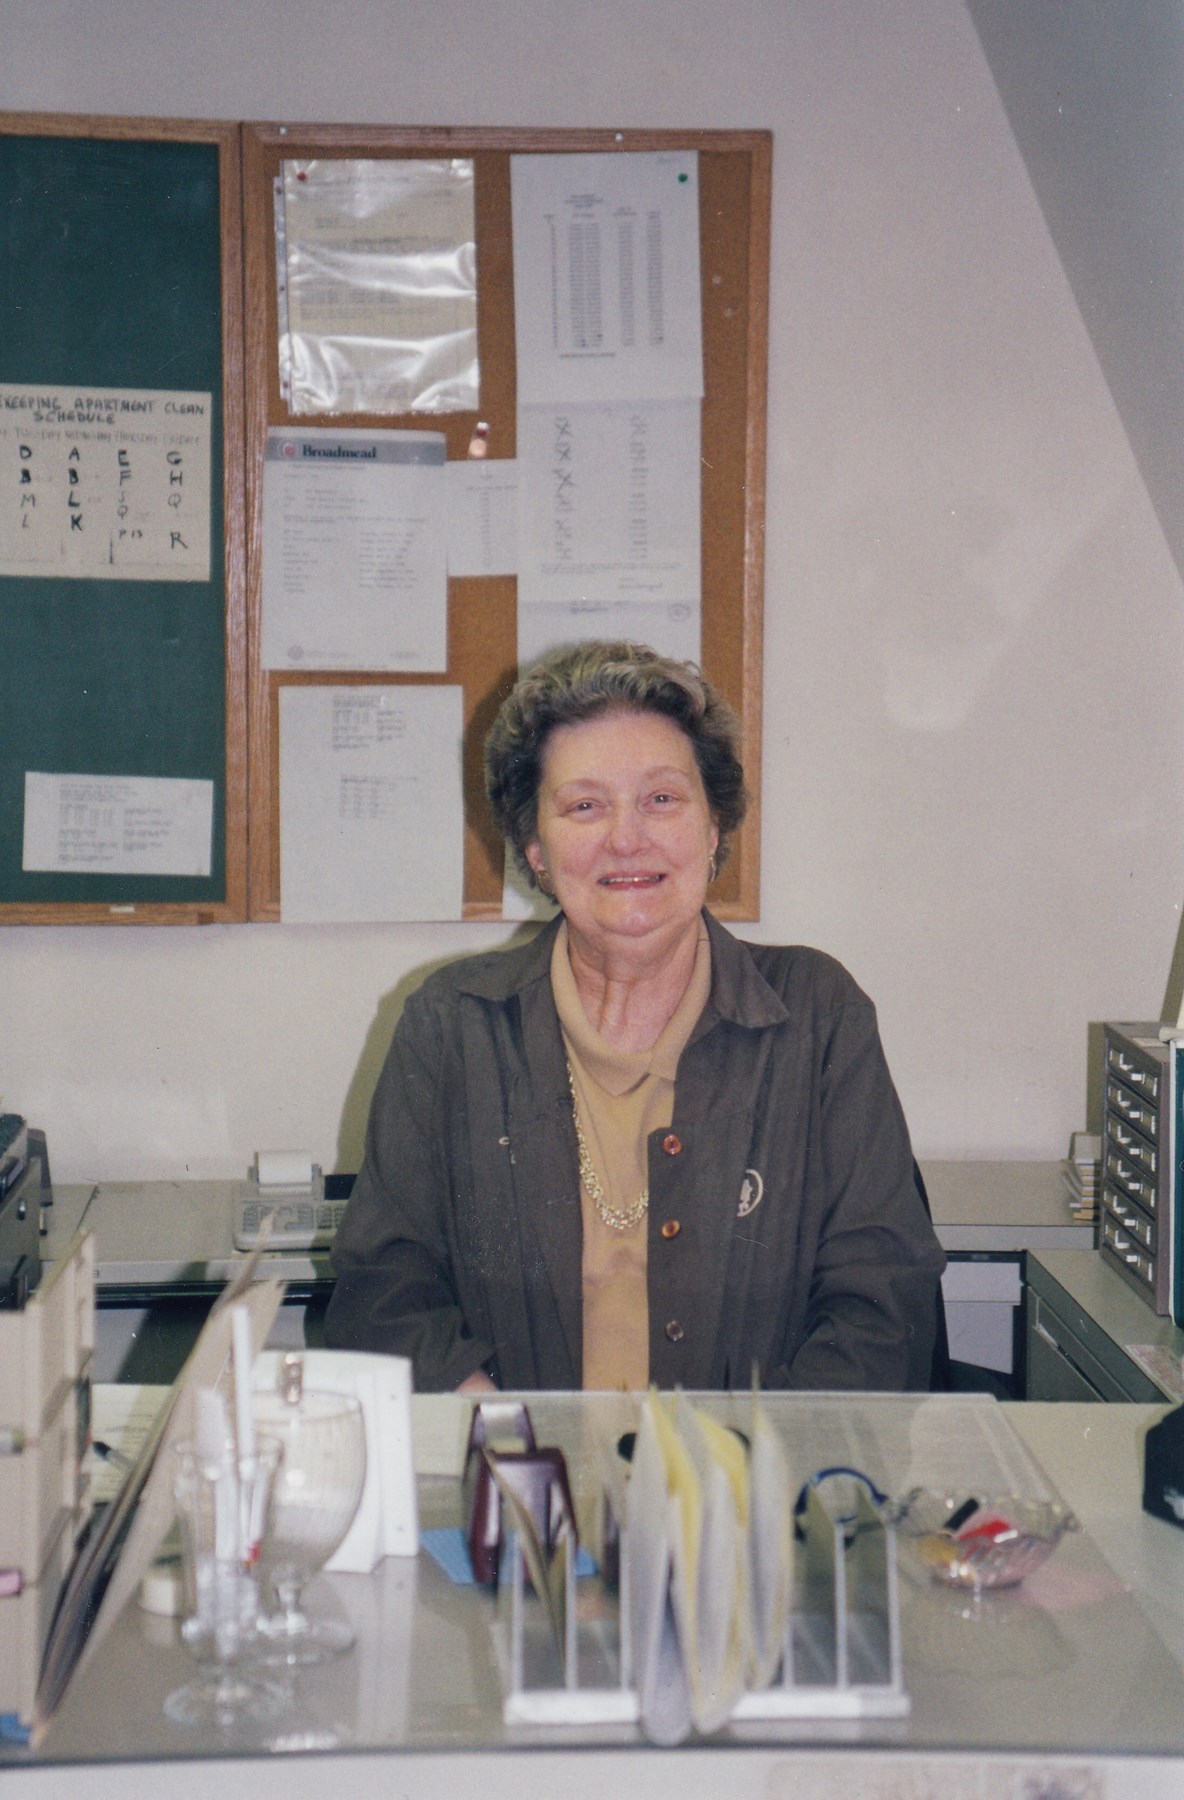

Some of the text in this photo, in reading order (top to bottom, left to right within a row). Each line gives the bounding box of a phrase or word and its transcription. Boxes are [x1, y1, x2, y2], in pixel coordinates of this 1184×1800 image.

[0, 394, 205, 416] KEEPING APARTMENT CLEAN
[34, 410, 116, 424] SCHEDULE
[19, 445, 183, 467] D A E G
[302, 444, 377, 459] Broadmead
[68, 468, 79, 485] B
[119, 469, 132, 486] F
[169, 470, 183, 486] H
[20, 494, 36, 508] M
[67, 490, 80, 507] L
[167, 493, 182, 510] Q
[71, 513, 83, 531] K
[169, 531, 188, 549] R
